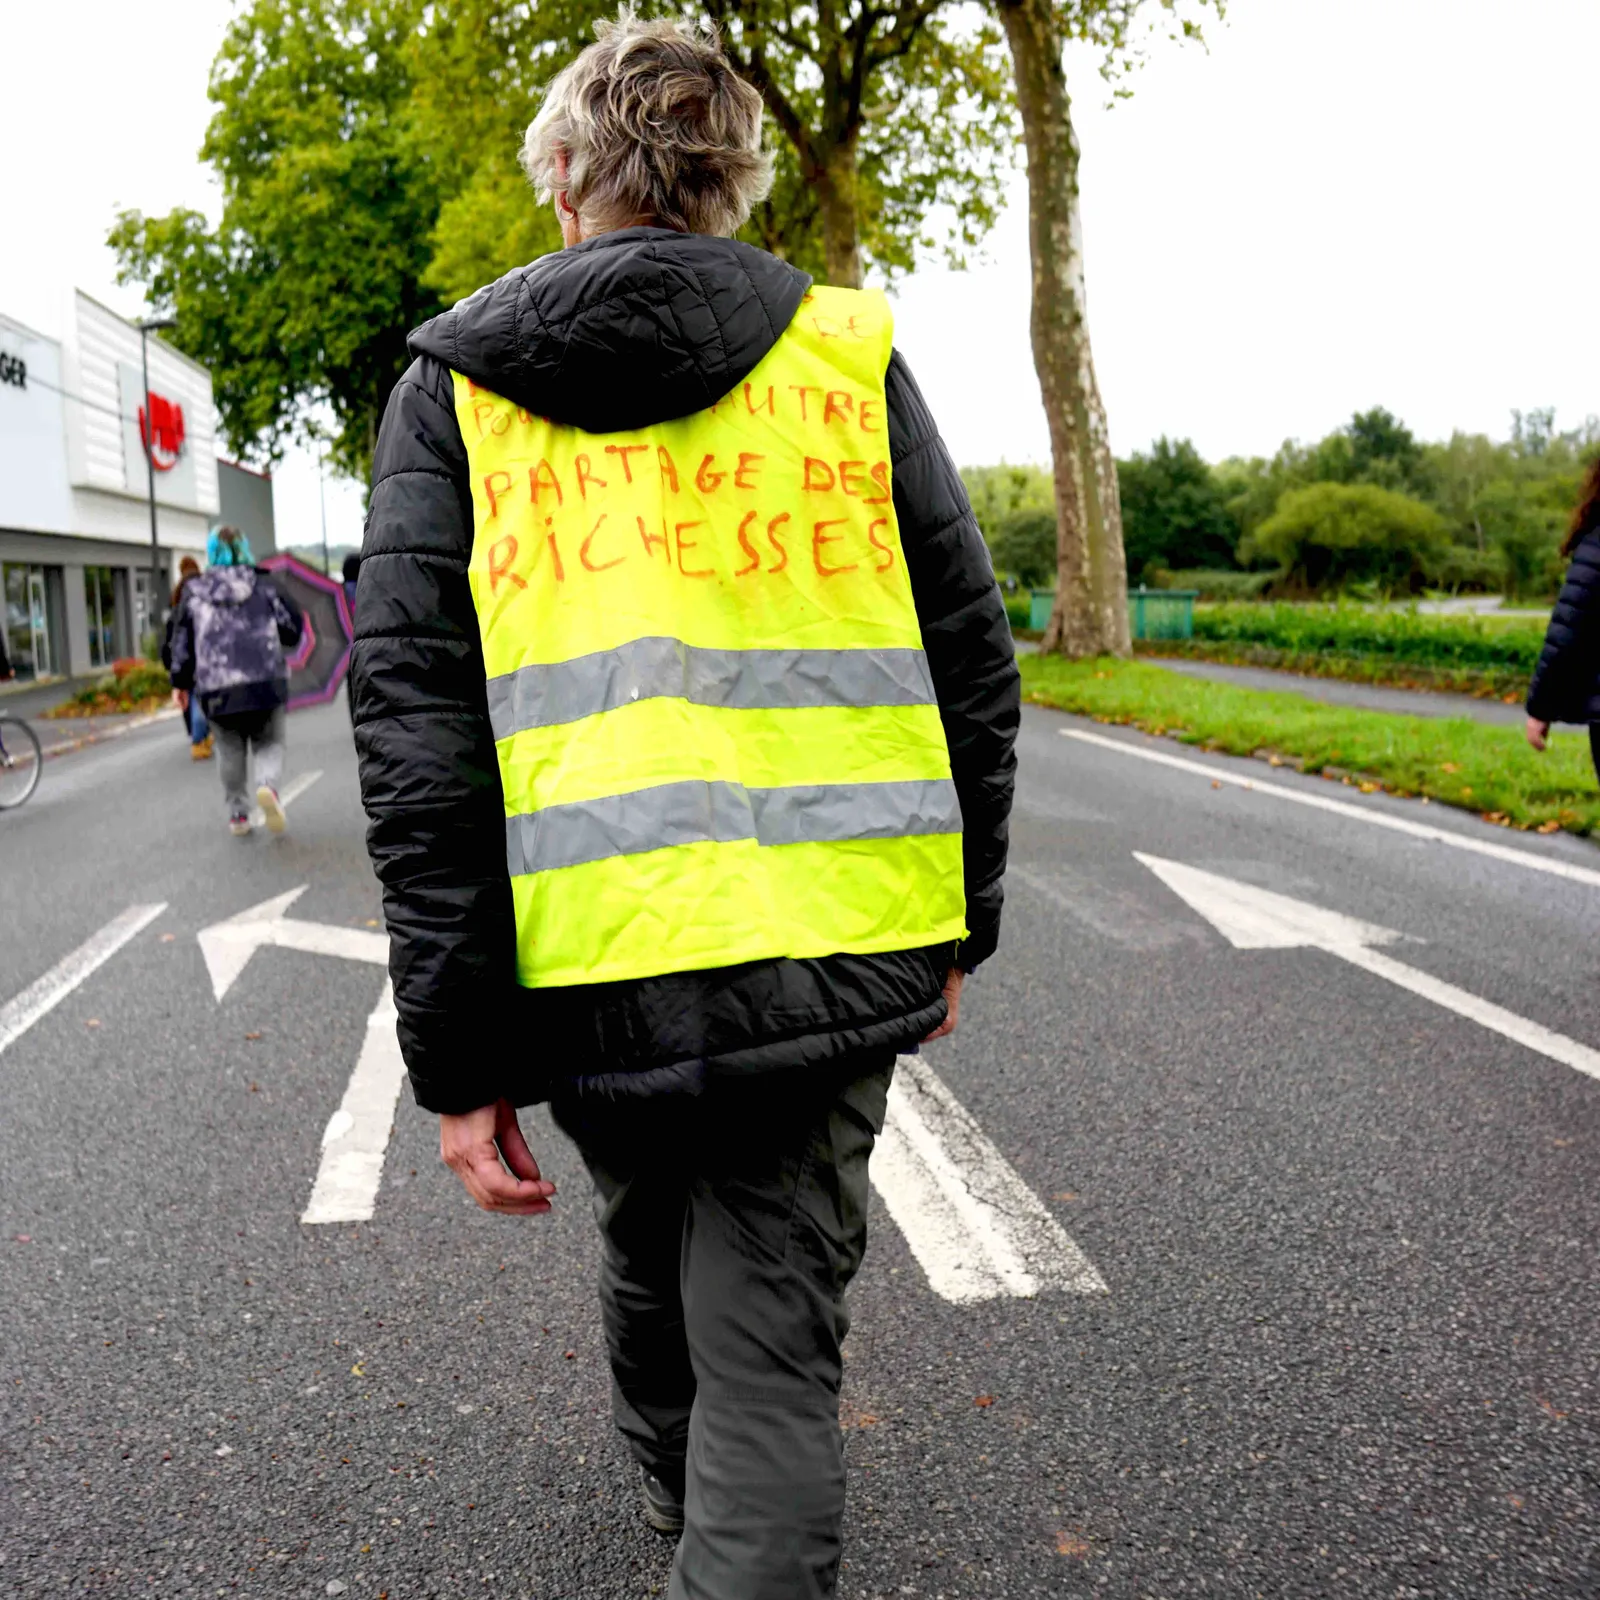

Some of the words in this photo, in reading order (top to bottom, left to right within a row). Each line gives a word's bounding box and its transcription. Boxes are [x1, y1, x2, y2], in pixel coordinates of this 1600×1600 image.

[473, 403, 560, 438] POU
[484, 444, 766, 518] PARTAGE
[801, 456, 892, 505] DES
